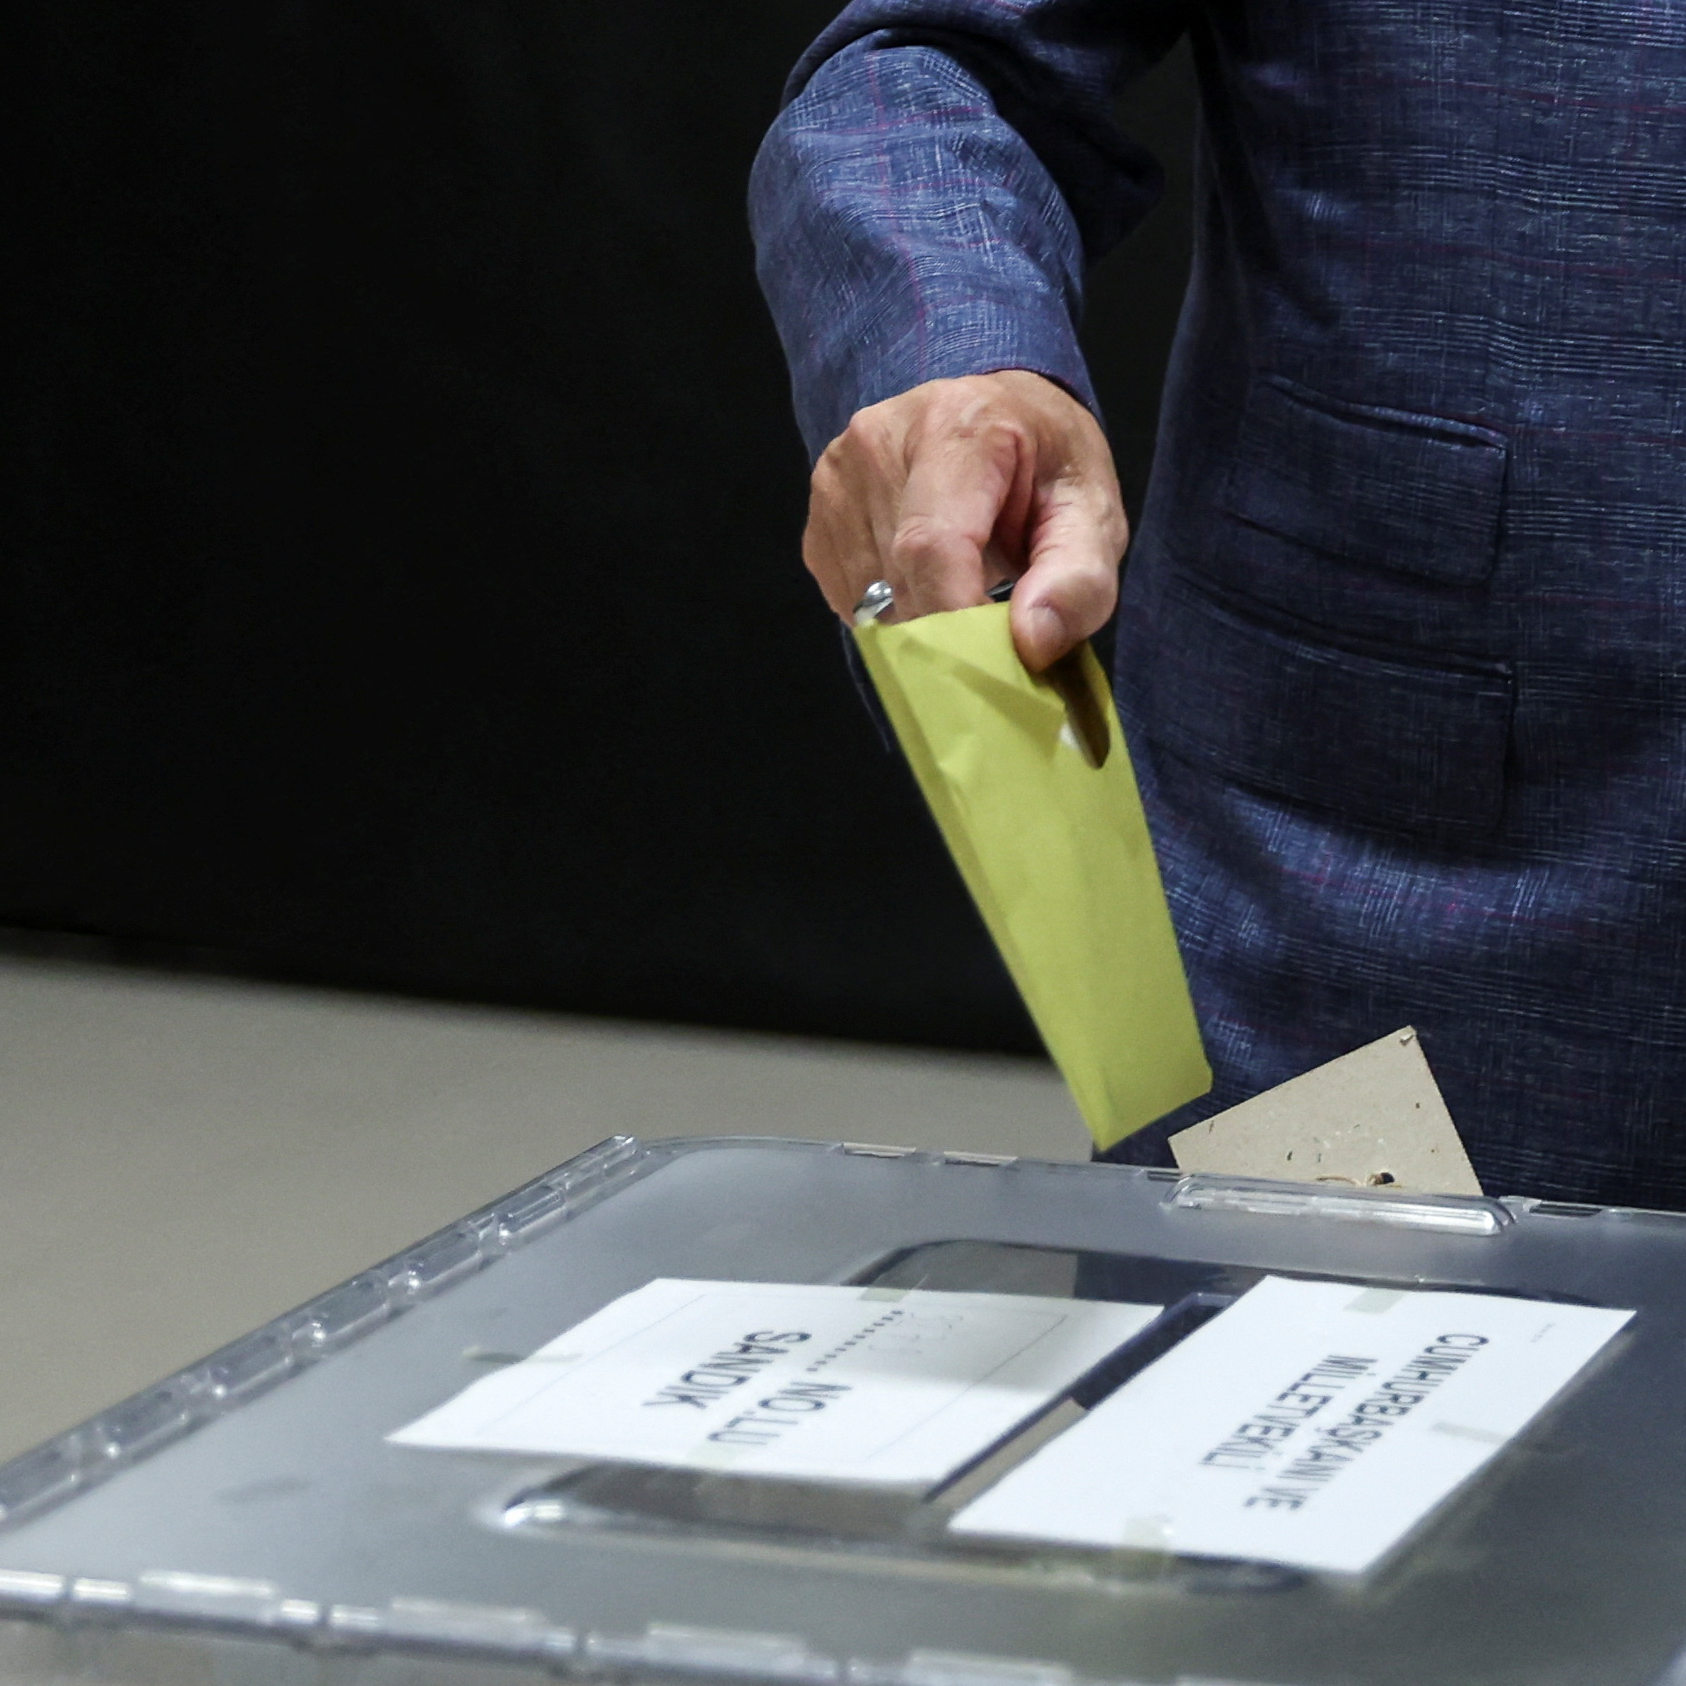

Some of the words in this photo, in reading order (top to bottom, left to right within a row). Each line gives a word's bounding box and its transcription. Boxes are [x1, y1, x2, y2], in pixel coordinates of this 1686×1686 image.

[642, 1329, 812, 1410] SANDIK
[1198, 1354, 1379, 1471] MİLLETVEKİLİ
[1275, 1332, 1490, 1482] CUMHURBAŞKANI
[1243, 1485, 1319, 1511] VE
